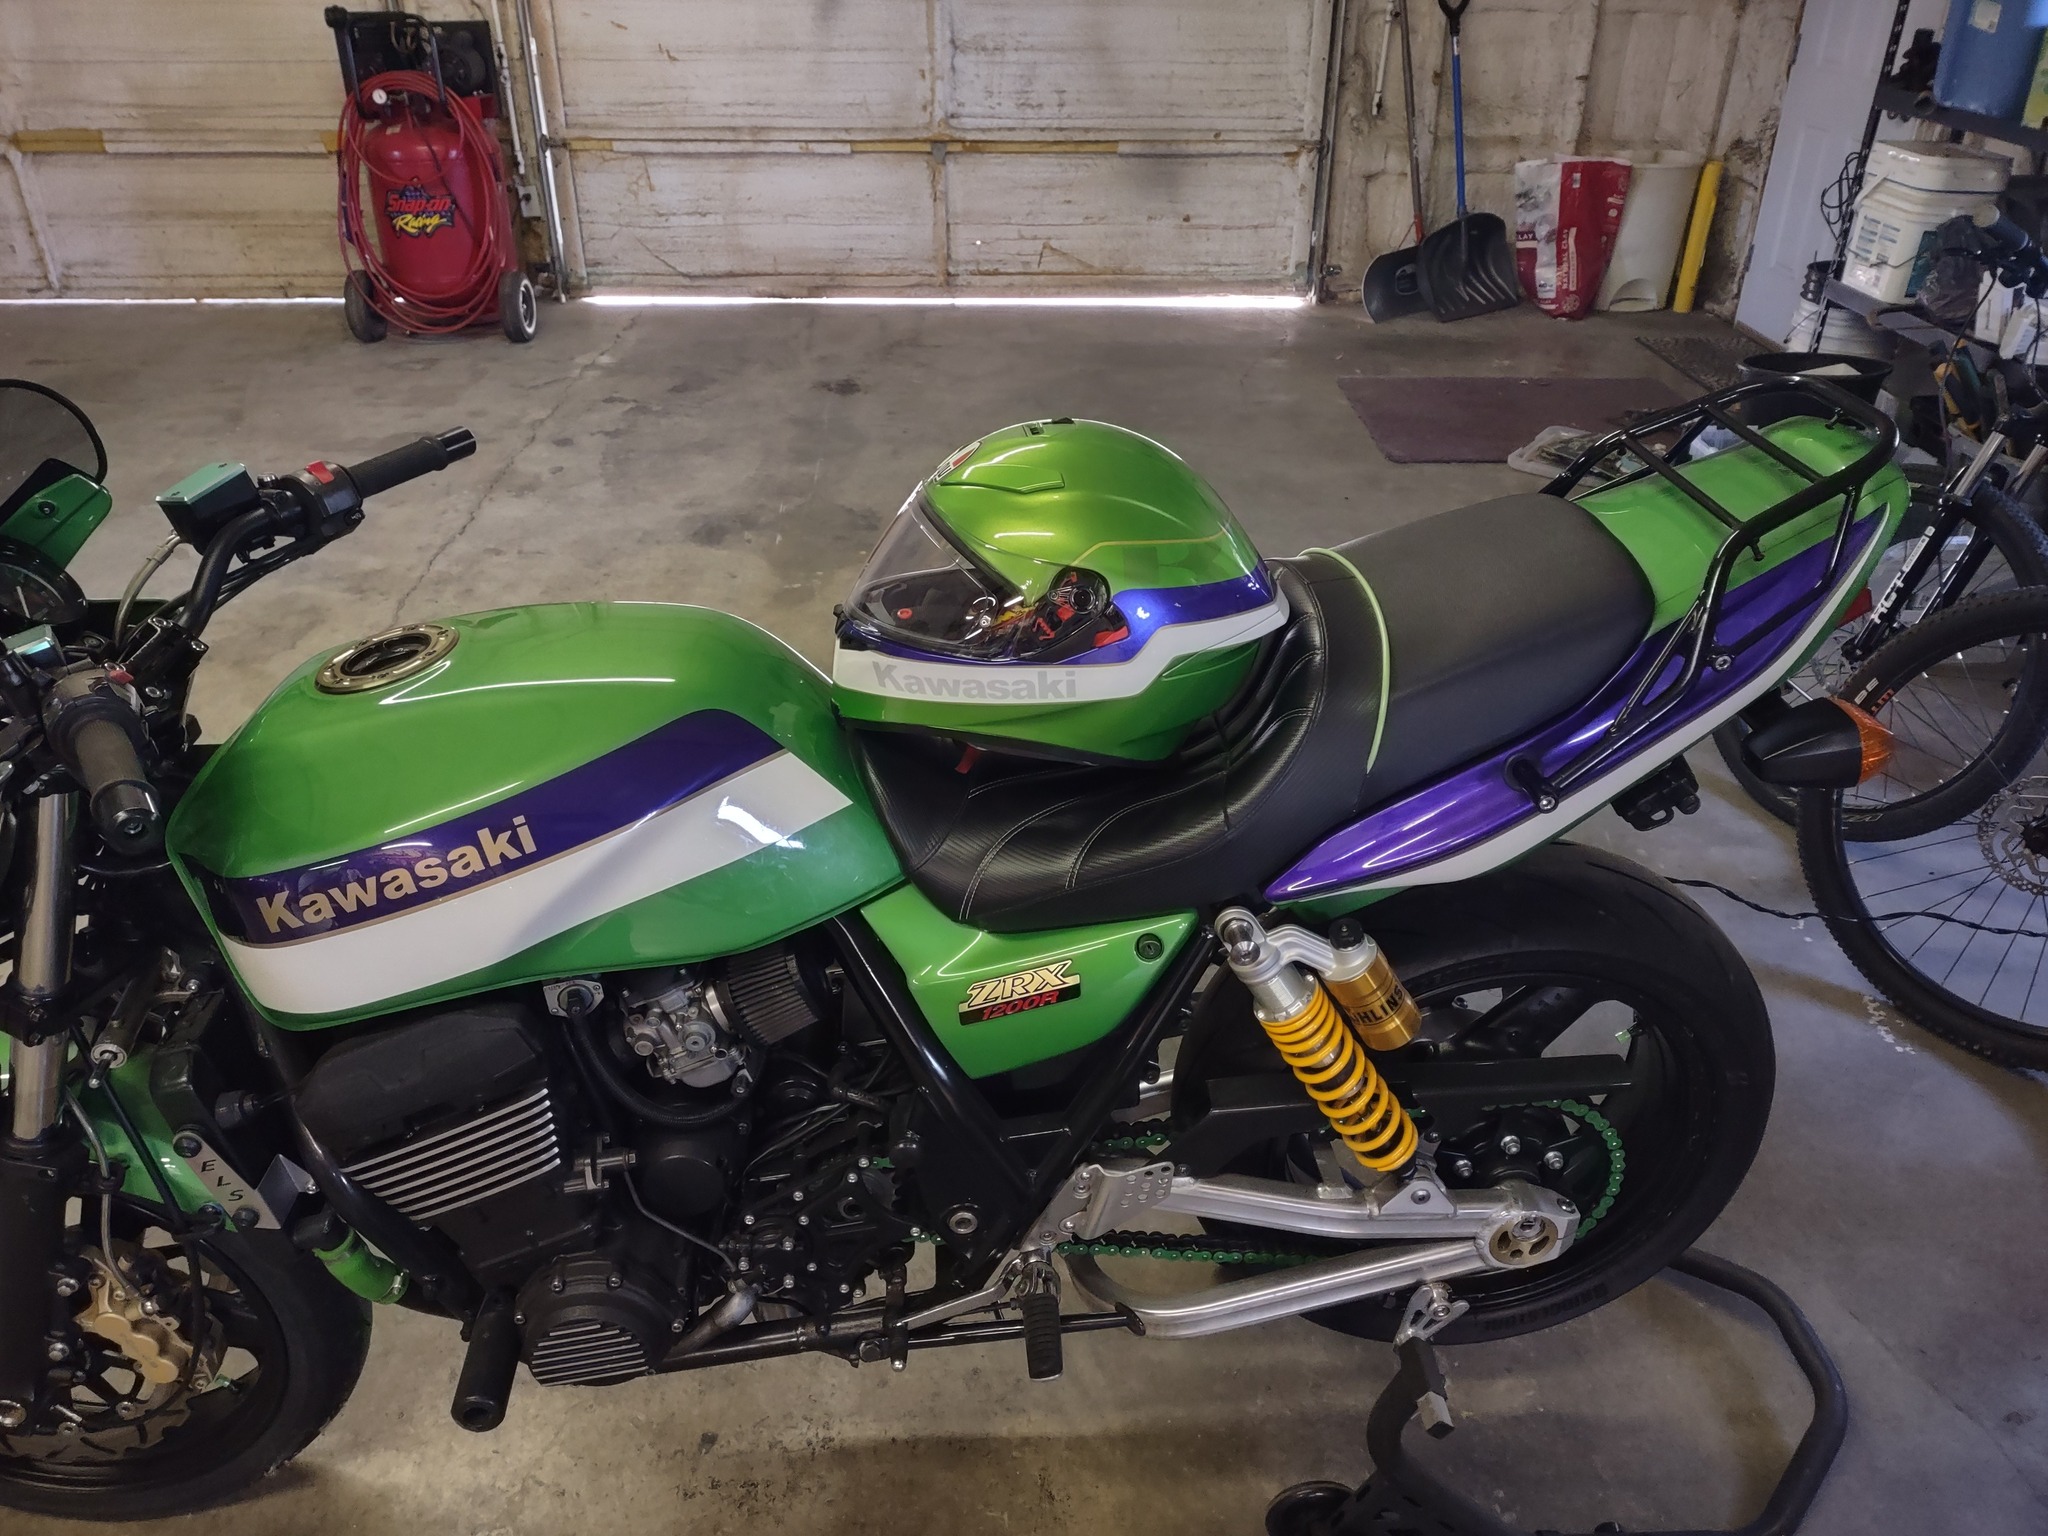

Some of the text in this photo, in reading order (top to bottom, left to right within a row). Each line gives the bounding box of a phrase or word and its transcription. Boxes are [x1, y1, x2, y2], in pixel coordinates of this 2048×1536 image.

[388, 195, 450, 215] Snap-on
[392, 213, 447, 234] Racing
[871, 660, 1078, 701] Kawasaki
[256, 814, 538, 934] Kawasaki
[967, 960, 1073, 1008] ZRX
[982, 989, 1060, 1021] 1200R
